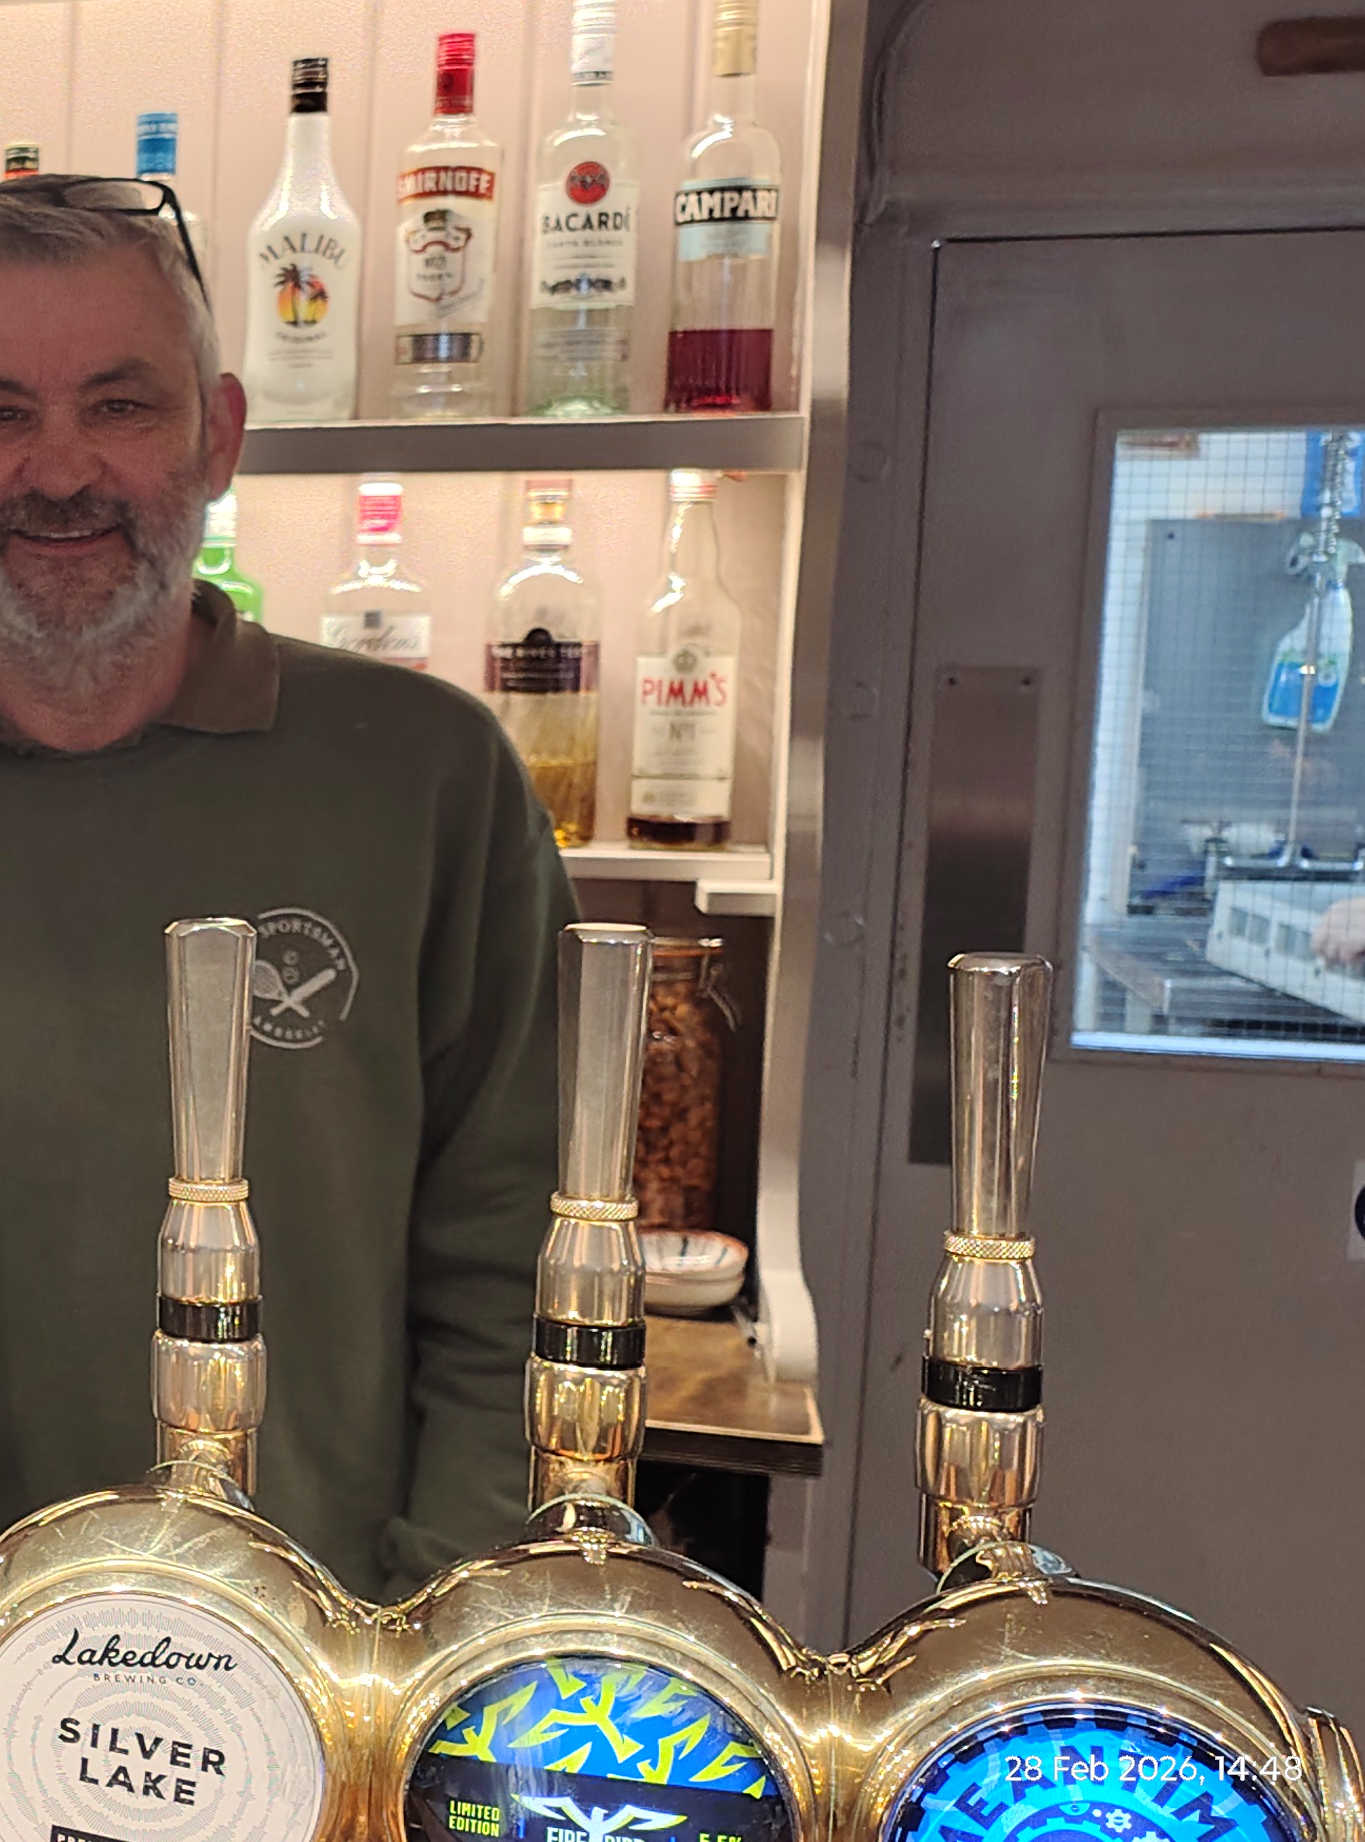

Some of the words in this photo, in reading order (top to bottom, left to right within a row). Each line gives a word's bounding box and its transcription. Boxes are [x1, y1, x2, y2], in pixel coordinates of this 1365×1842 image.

[676, 189, 777, 223] CAMPARI
[259, 232, 349, 270] MALIBU
[642, 672, 727, 707] PIMM'S
[51, 1628, 238, 1673] Lakedown
[92, 1672, 168, 1686] BREWING
[58, 1716, 226, 1777] SILVER
[78, 1756, 198, 1807] LAKE
[939, 1744, 1238, 1842] EANTIM
[449, 1800, 500, 1821] LIMITED
[449, 1816, 500, 1837] EDITION
